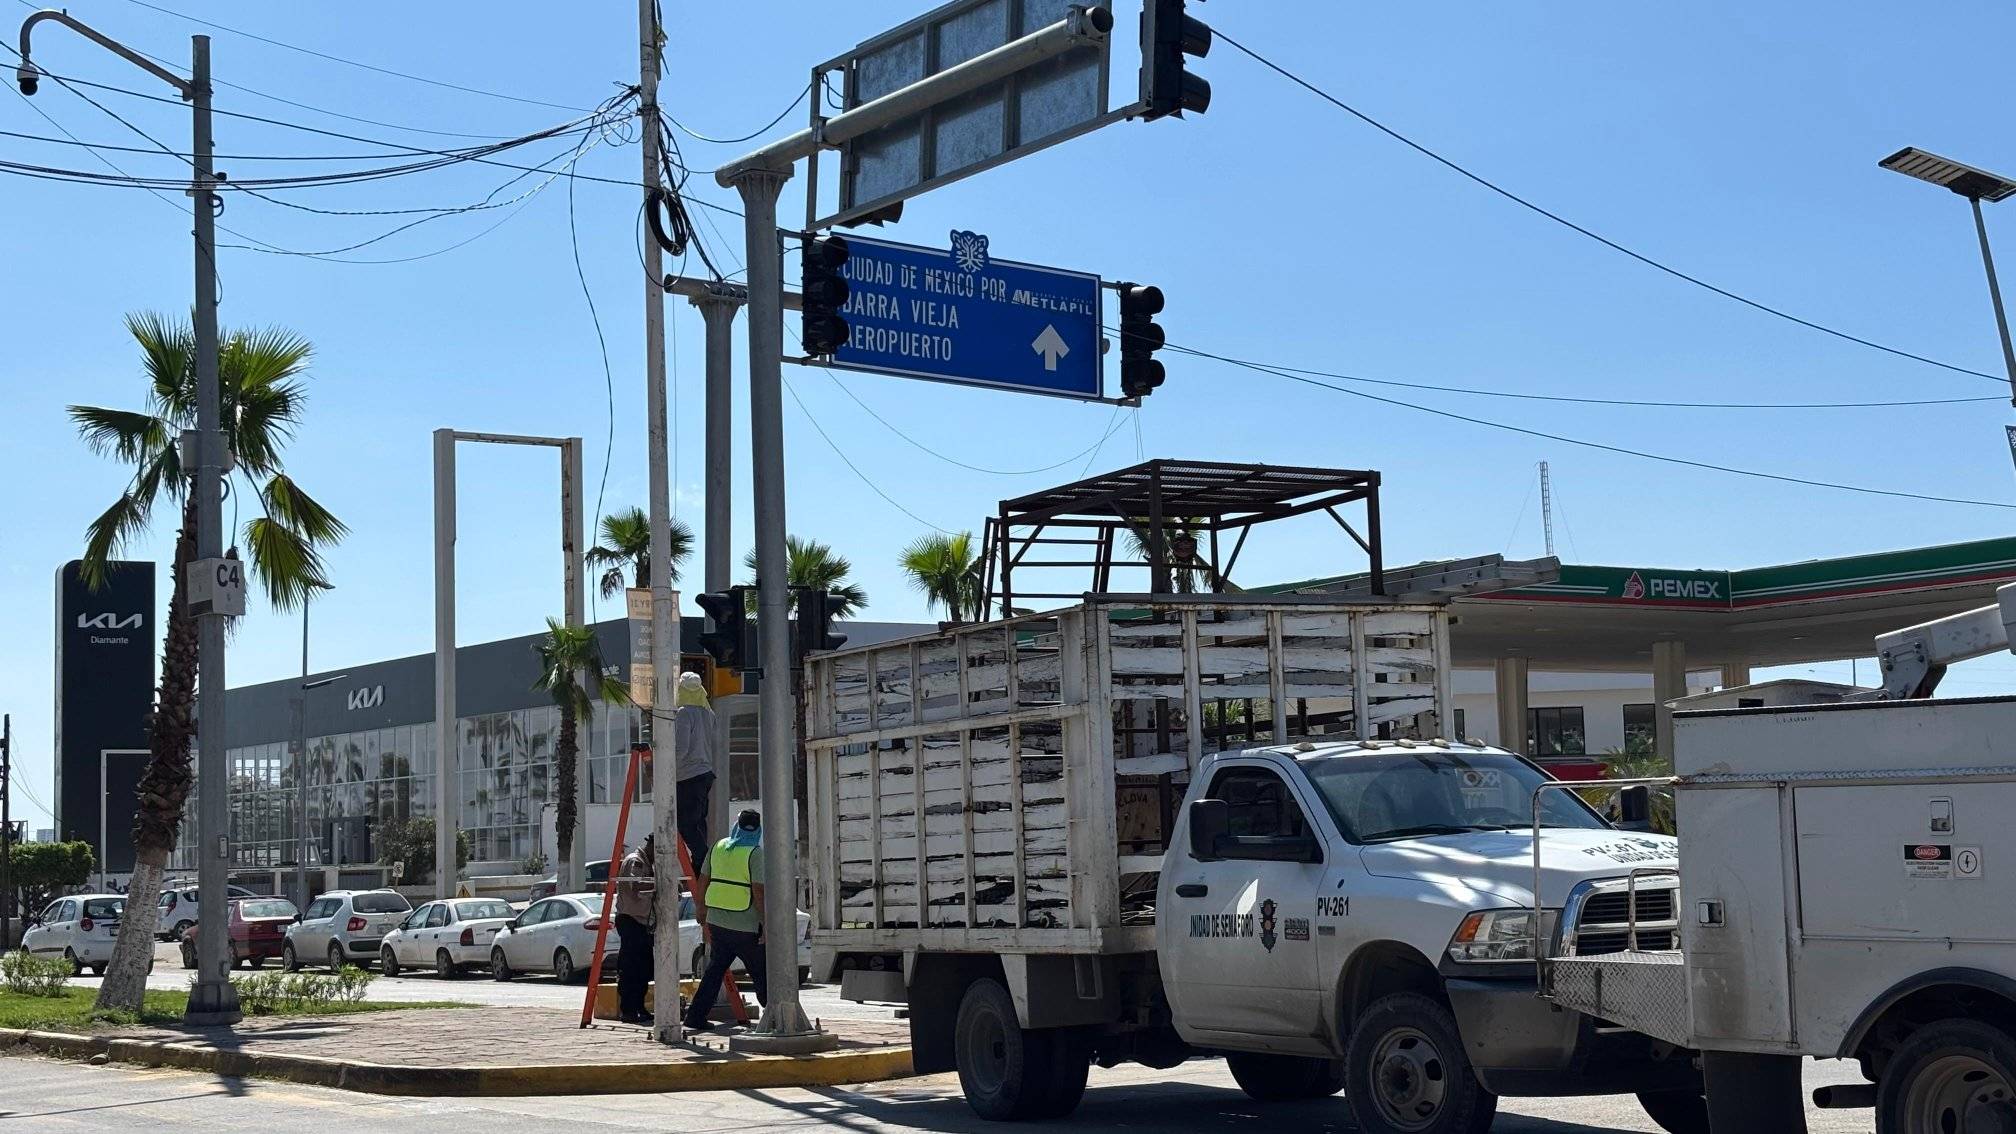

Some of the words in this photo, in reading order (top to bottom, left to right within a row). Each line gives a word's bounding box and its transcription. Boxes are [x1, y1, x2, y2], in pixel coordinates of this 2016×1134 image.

[842, 256, 893, 285] CIUDAD
[901, 264, 917, 289] DE
[925, 268, 974, 297] MEXICO
[981, 276, 1006, 303] POR
[843, 285, 901, 321] BARRA
[911, 299, 959, 329] VIEJA
[842, 323, 952, 361] AEROPUERTO
[216, 563, 240, 589] C4
[1650, 578, 1720, 598] PEMEX
[77, 612, 143, 629] KIA
[90, 635, 129, 644] Diamante
[347, 685, 384, 711] KIA
[1916, 848, 1939, 856] DANGER
[1317, 896, 1350, 917] PV-261
[1211, 914, 1220, 938] DE
